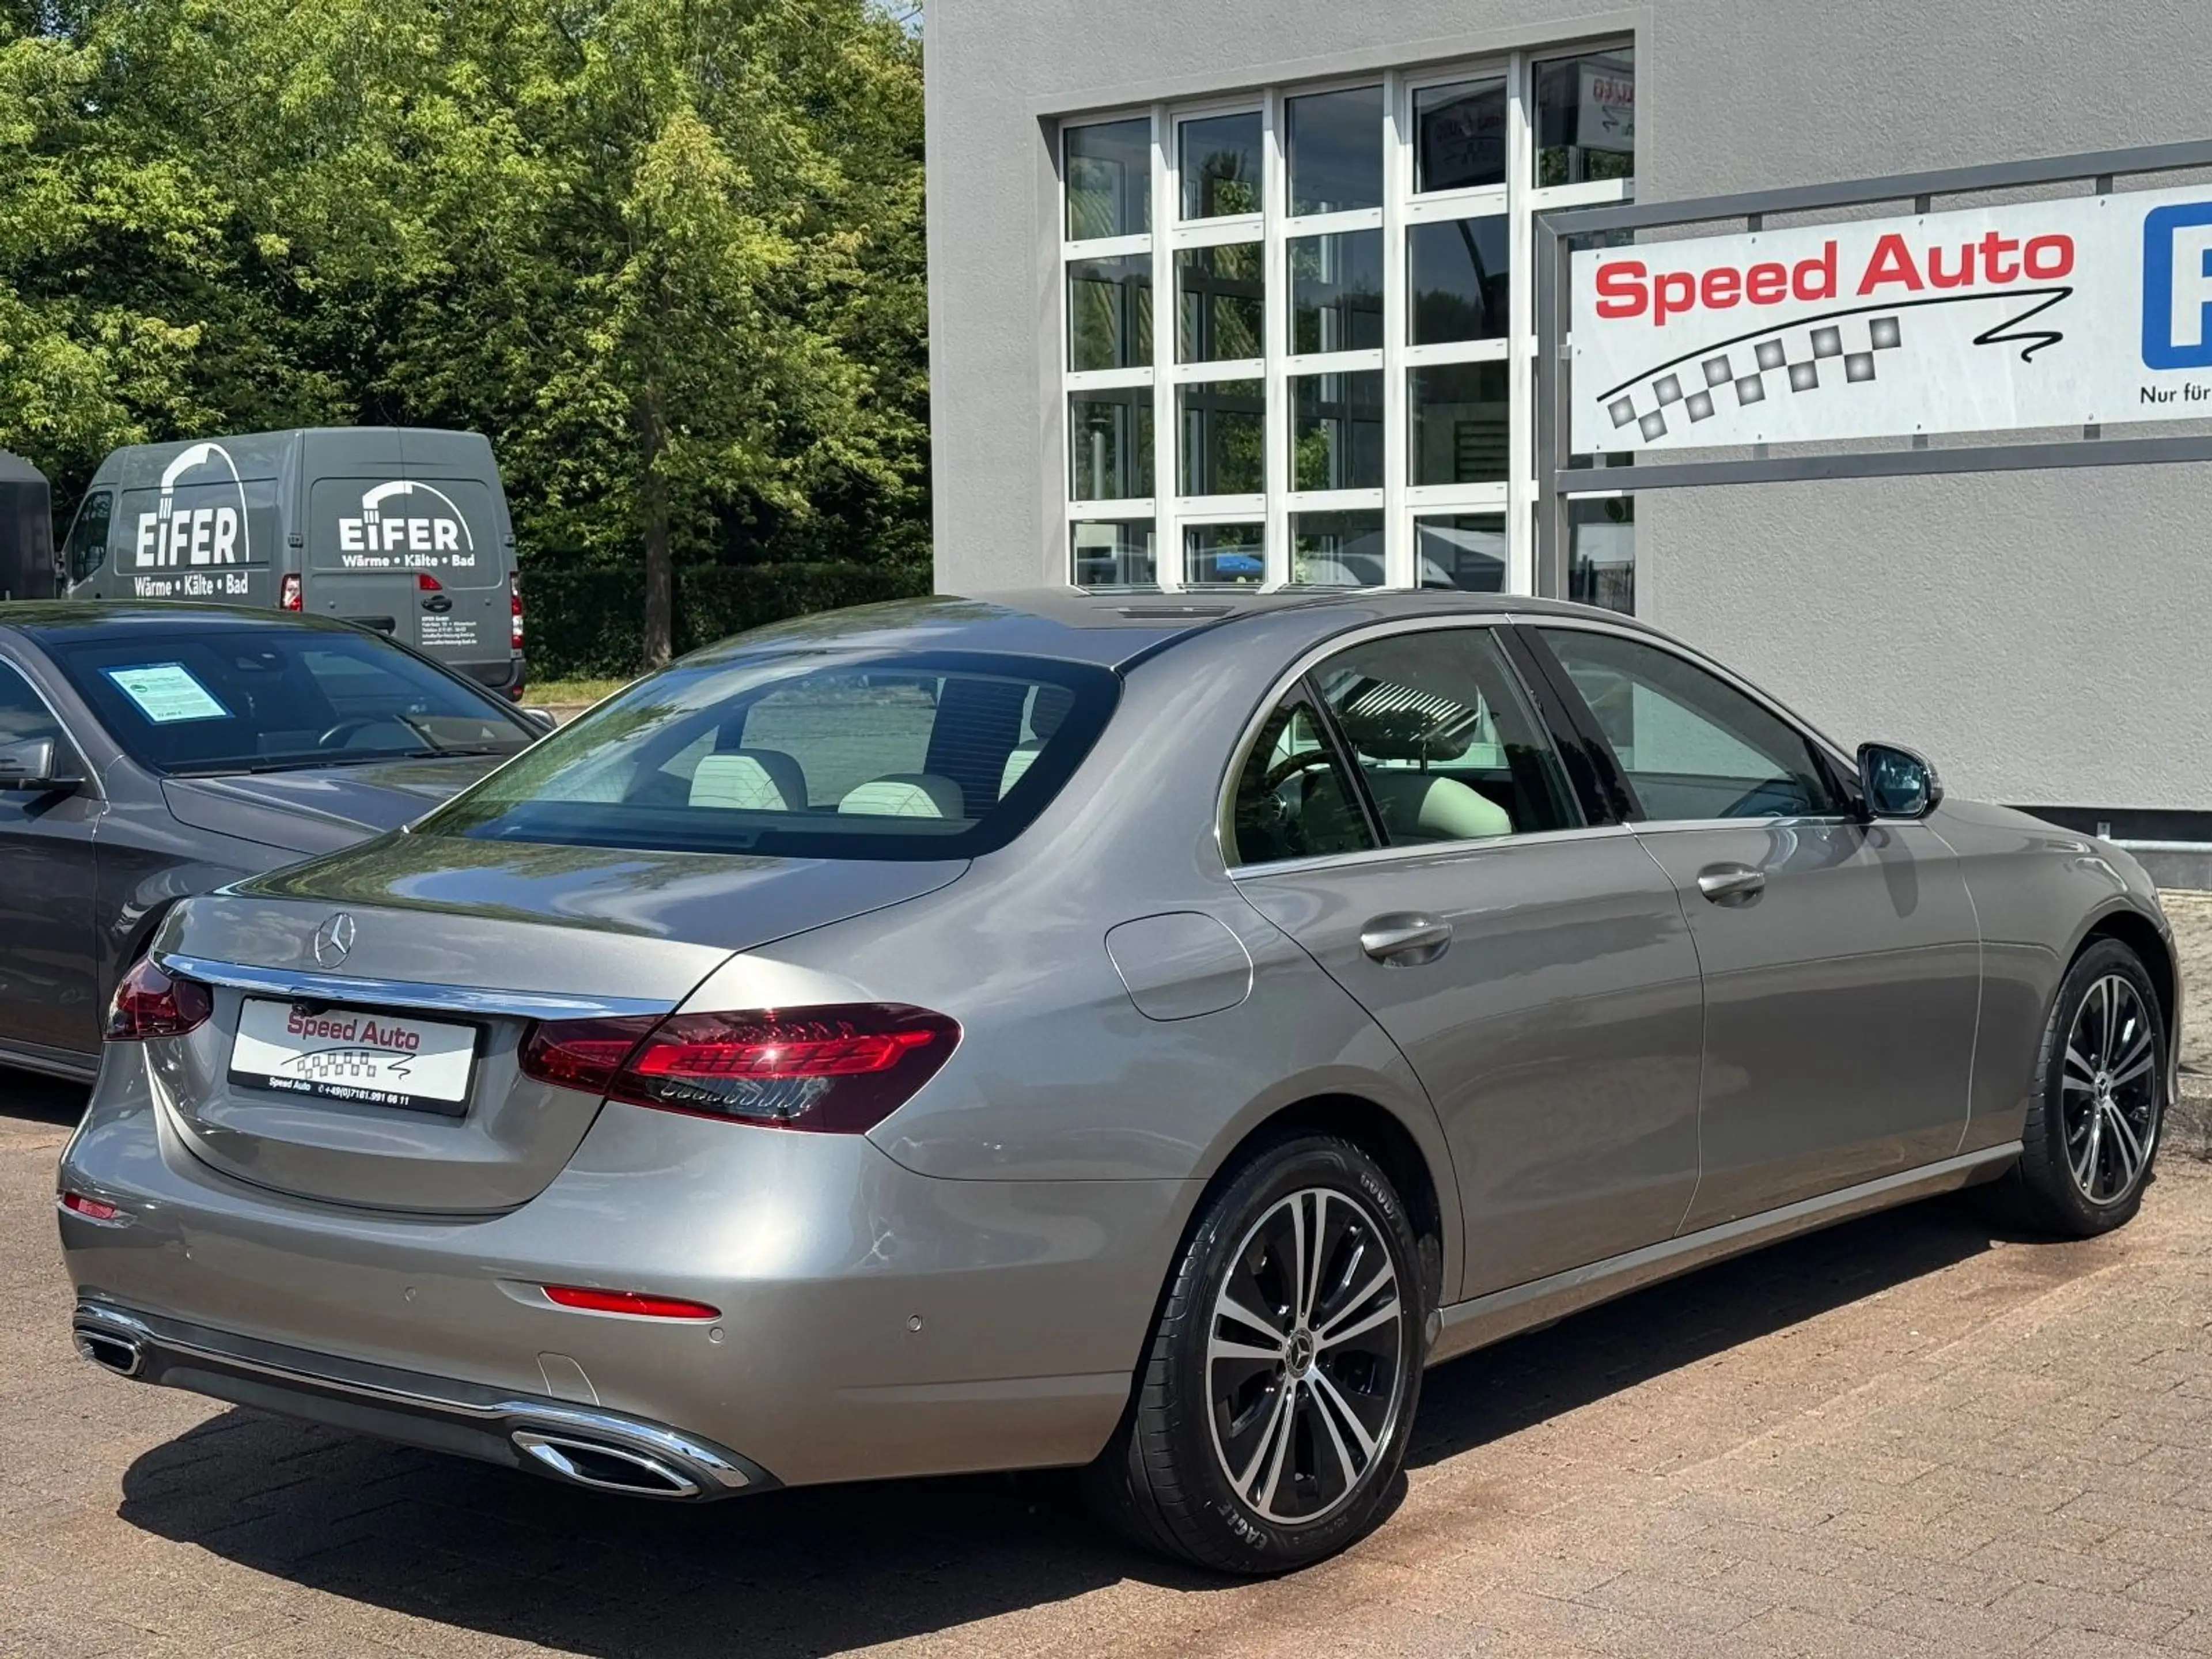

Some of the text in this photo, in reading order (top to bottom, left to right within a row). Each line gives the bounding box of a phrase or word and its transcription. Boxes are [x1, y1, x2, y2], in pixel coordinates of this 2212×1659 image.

[1594, 232, 2075, 326] Speed Auto
[2140, 382, 2212, 404] Nur für
[342, 554, 475, 567] Wärme Kälte Bad
[134, 573, 249, 597] Wärme Kälte Bad
[287, 1013, 421, 1050] Speed Auto
[268, 1077, 292, 1089] Speed
[293, 1080, 312, 1091] Auto
[1217, 1499, 1268, 1551] EAGLE
